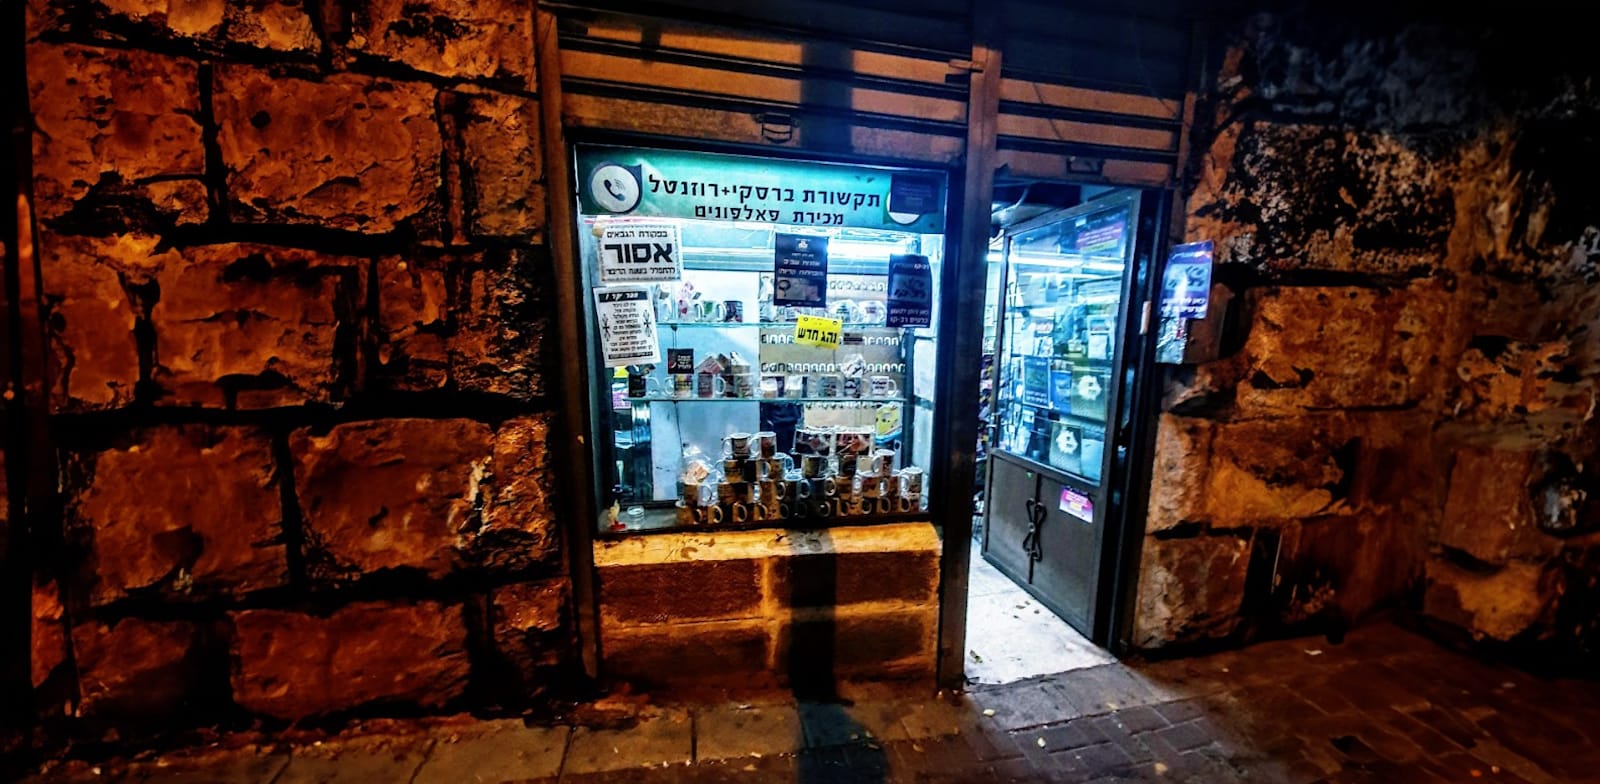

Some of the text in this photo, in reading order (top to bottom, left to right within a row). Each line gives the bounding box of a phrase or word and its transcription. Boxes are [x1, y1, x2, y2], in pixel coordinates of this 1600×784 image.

[648, 173, 795, 204] ברסקי+רוזנטל
[802, 189, 881, 210] תקשורת
[694, 204, 844, 225] מכירת פאלפונים
[606, 230, 635, 238] הגבאים
[604, 243, 673, 264] אסור
[797, 327, 838, 344] נהג חדש
